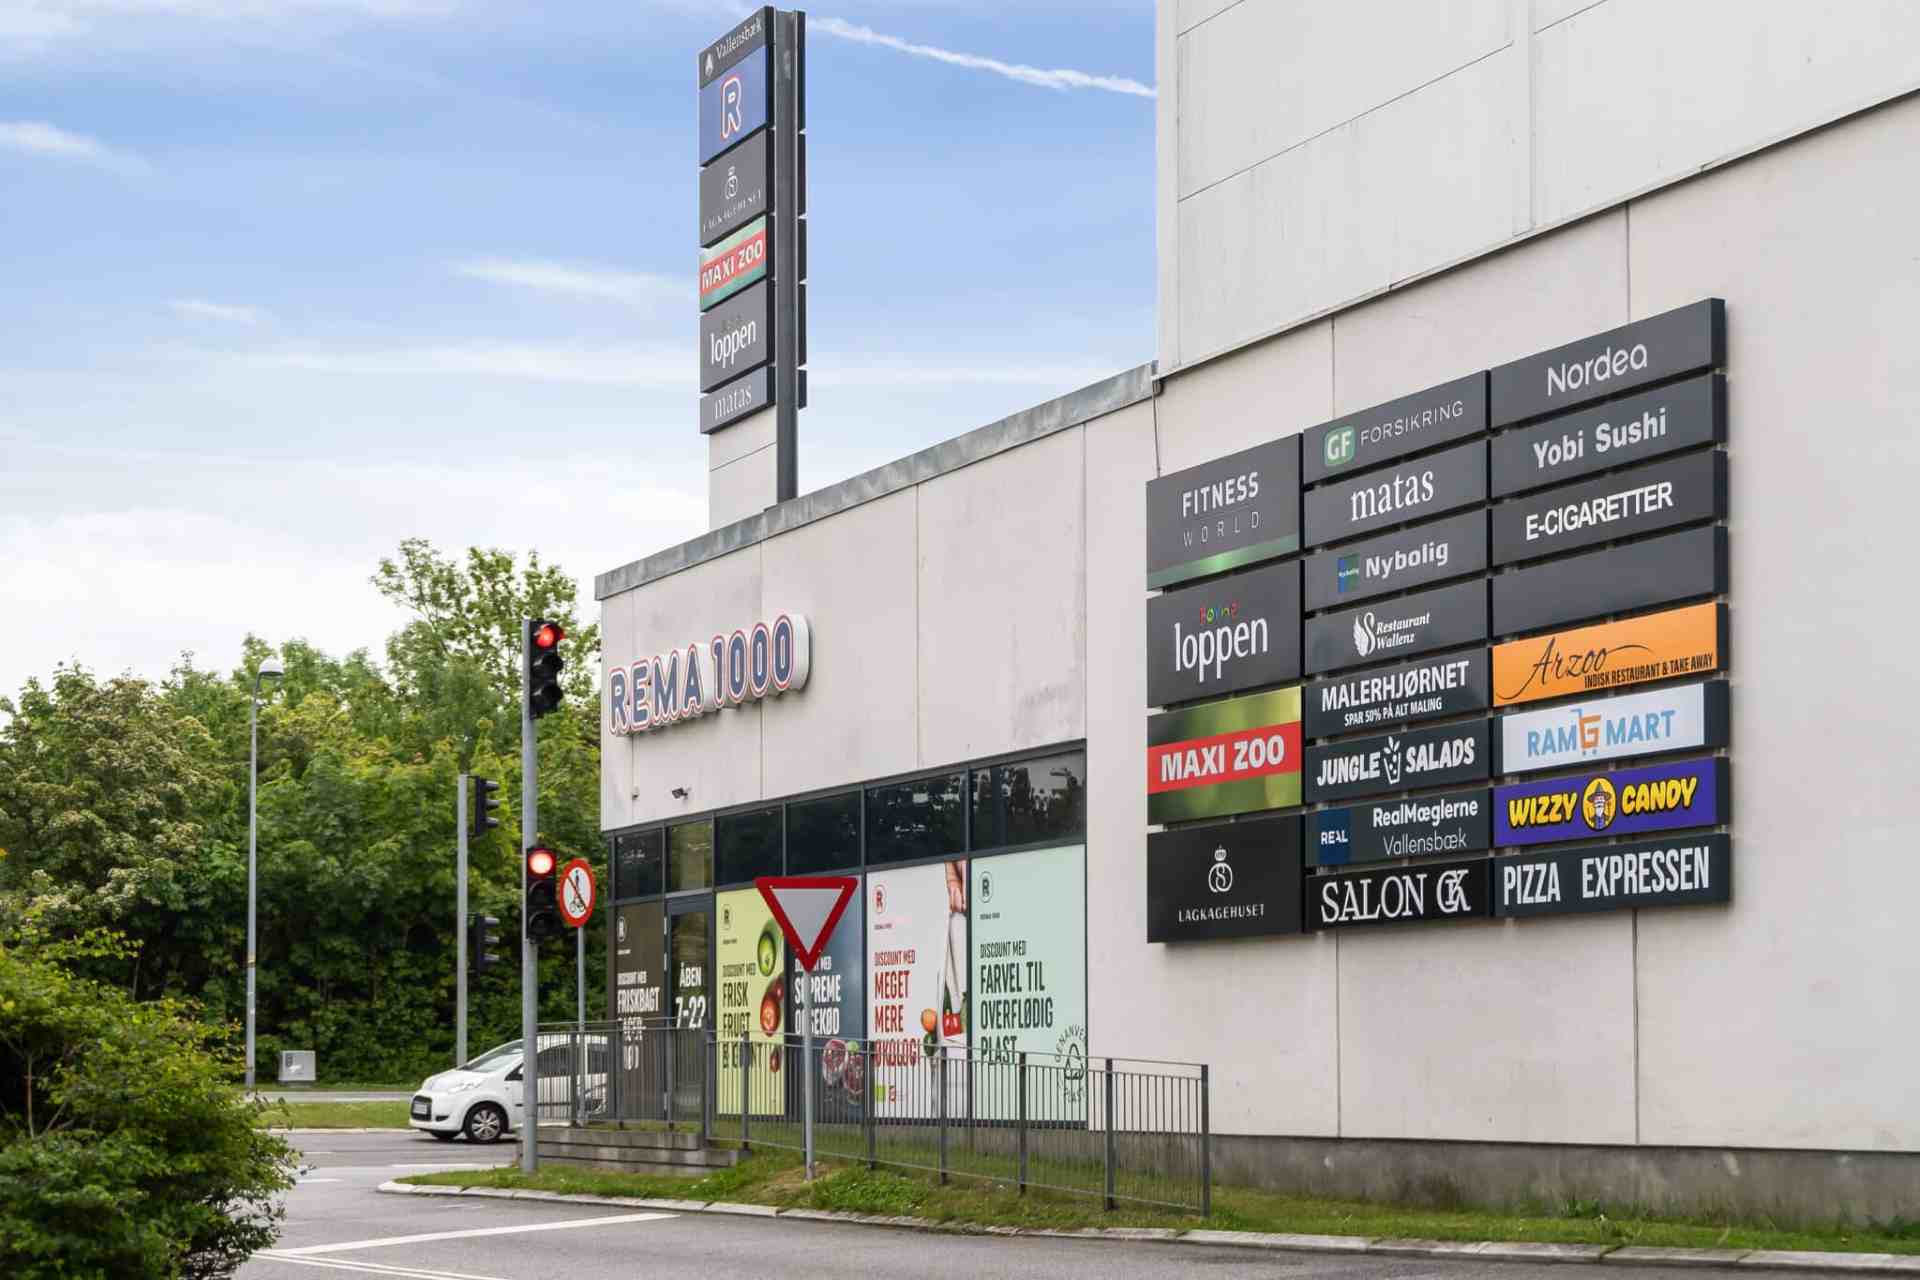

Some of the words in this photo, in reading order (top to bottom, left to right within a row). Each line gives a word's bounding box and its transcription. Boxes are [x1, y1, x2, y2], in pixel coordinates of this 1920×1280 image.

[702, 256, 736, 292] MAXI
[738, 239, 763, 269] ZOO
[710, 320, 756, 369] loppen
[1547, 343, 1648, 396] Nordea
[714, 384, 752, 420] matas
[1327, 431, 1353, 460] GF
[1360, 400, 1464, 447] FORSIKRING
[1533, 430, 1584, 469] Yobi
[1595, 407, 1667, 453] Sushi
[1182, 471, 1259, 518] FITNESS
[1350, 470, 1434, 522] matas
[1525, 481, 1674, 541] E-CIGARETTER
[1183, 511, 1261, 548] WORLD
[1365, 542, 1449, 579] Nybolig
[1376, 612, 1431, 635] Restaurant
[1174, 617, 1268, 683] loppen
[1515, 636, 1610, 695] Arzoo
[609, 643, 704, 735] REMA
[711, 614, 794, 710] 1000
[1321, 660, 1470, 712] MALERHJØRNET
[1584, 672, 1611, 689] INDISK
[1611, 662, 1660, 683] RESTAURANT
[1662, 662, 1669, 676] &
[1670, 656, 1690, 674] TAKE
[1690, 653, 1713, 672] AWAY
[1344, 712, 1364, 727] SPAR
[1365, 708, 1382, 723] 50%
[1382, 702, 1394, 719] PÅ
[1395, 702, 1409, 718] ALT
[1410, 697, 1443, 715] MALING
[1527, 724, 1577, 758] RAM
[1605, 710, 1676, 746] MART
[1160, 744, 1225, 782] MAXI
[1233, 734, 1285, 772] ZOO
[1316, 752, 1381, 786] JUNGLE
[1405, 737, 1476, 774] SALADS
[1372, 798, 1479, 828] RealMæglerne
[1508, 792, 1578, 828] WIZZY
[1621, 776, 1698, 816] CANDY
[1320, 830, 1349, 845] REAL
[1382, 827, 1468, 857] Vallensbæk
[1503, 862, 1561, 906] PIZZA
[1581, 846, 1710, 899] EXPRESSEN
[1178, 903, 1265, 923] LAGKAGEHUSET
[1321, 873, 1428, 923] SALON
[874, 950, 902, 967] DISCOUNT
[903, 950, 916, 965] MED
[980, 941, 1011, 959] DISCOUNT
[1012, 940, 1027, 956] MED
[679, 962, 702, 988] ÅBEN
[874, 970, 910, 999] MEGET
[980, 963, 1022, 995] FARVEL
[1026, 961, 1045, 992] TIL
[617, 987, 661, 1014] FRISKBAGT
[675, 995, 706, 1030] 7-22
[722, 981, 749, 1008] FRISK
[722, 1012, 751, 1038] FRUGT
[874, 1005, 904, 1033] MERE
[980, 997, 1054, 1031] OVERFLØDIG
[980, 1035, 1018, 1065] PLAST
